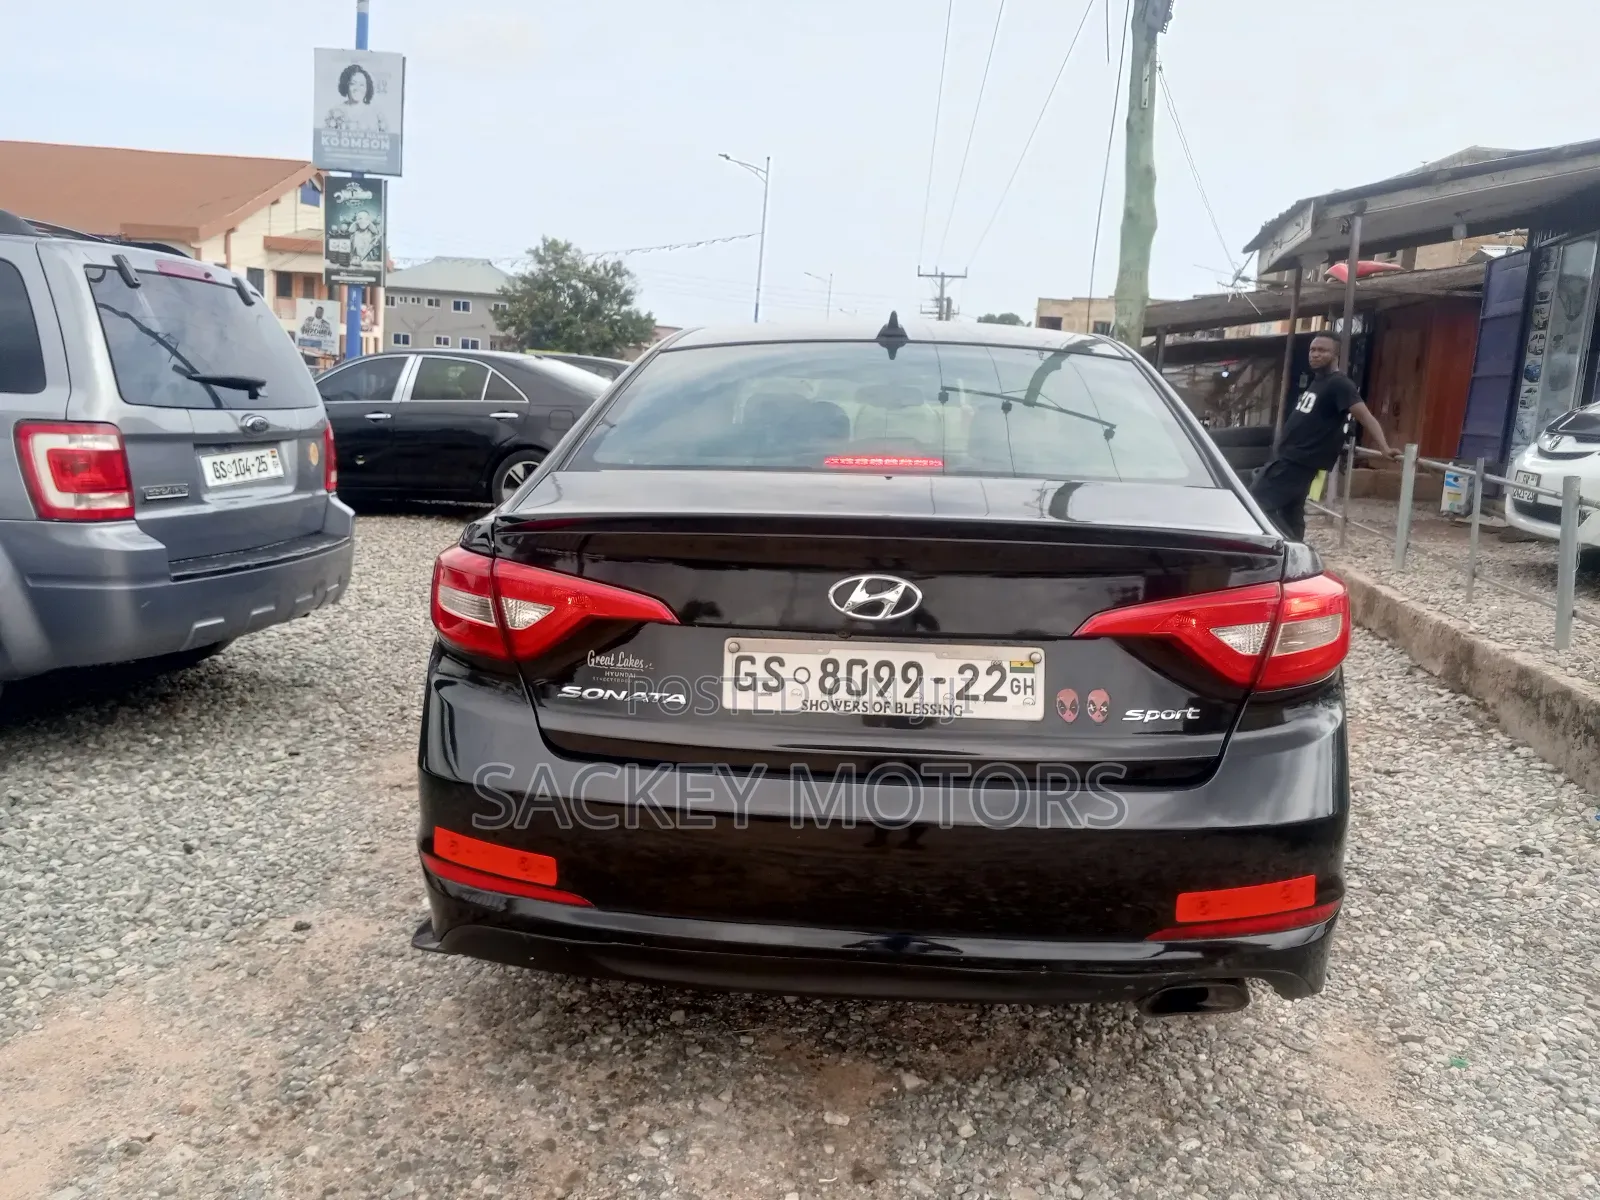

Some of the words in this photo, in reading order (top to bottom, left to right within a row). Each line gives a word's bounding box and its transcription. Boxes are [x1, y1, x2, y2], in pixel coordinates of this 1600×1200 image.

[321, 136, 390, 151] KOOMSON
[212, 460, 228, 479] GS
[587, 650, 615, 667] Great
[616, 651, 644, 669] Lakes
[605, 671, 636, 679] HYUNDAI
[734, 655, 785, 693] GS
[557, 686, 687, 705] SONATA
[1010, 677, 1035, 696] GH
[801, 700, 869, 714] SHOWERS
[873, 702, 892, 714] OF
[895, 702, 963, 717] BLESSING
[1121, 707, 1201, 723] Sport
